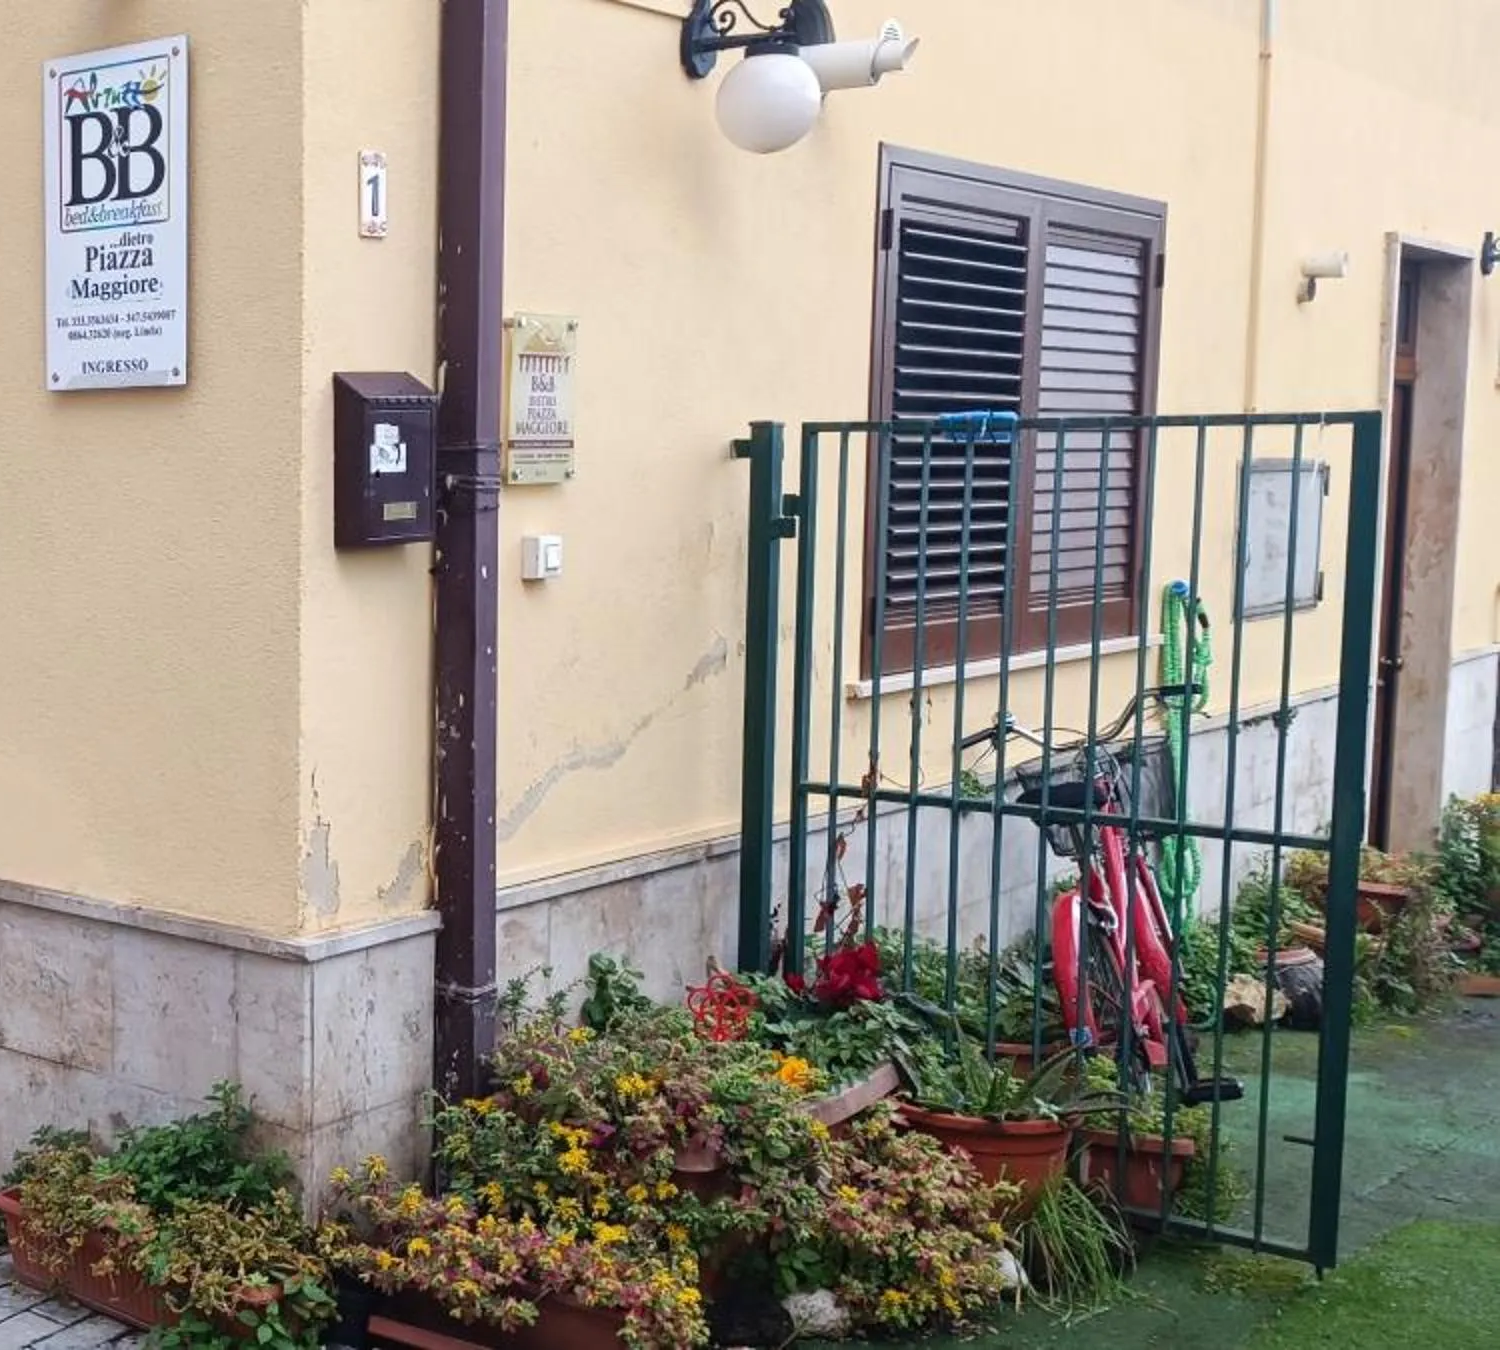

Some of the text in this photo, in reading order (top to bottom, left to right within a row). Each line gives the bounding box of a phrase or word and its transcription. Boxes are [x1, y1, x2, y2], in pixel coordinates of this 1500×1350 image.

[64, 103, 165, 206] B&B
[367, 174, 379, 217] 1
[85, 245, 154, 272] Piazza
[71, 274, 159, 301] Maggiore
[82, 359, 149, 374] INGRESSO
[531, 375, 555, 393] B&B
[515, 420, 569, 435] MAGGIORE
